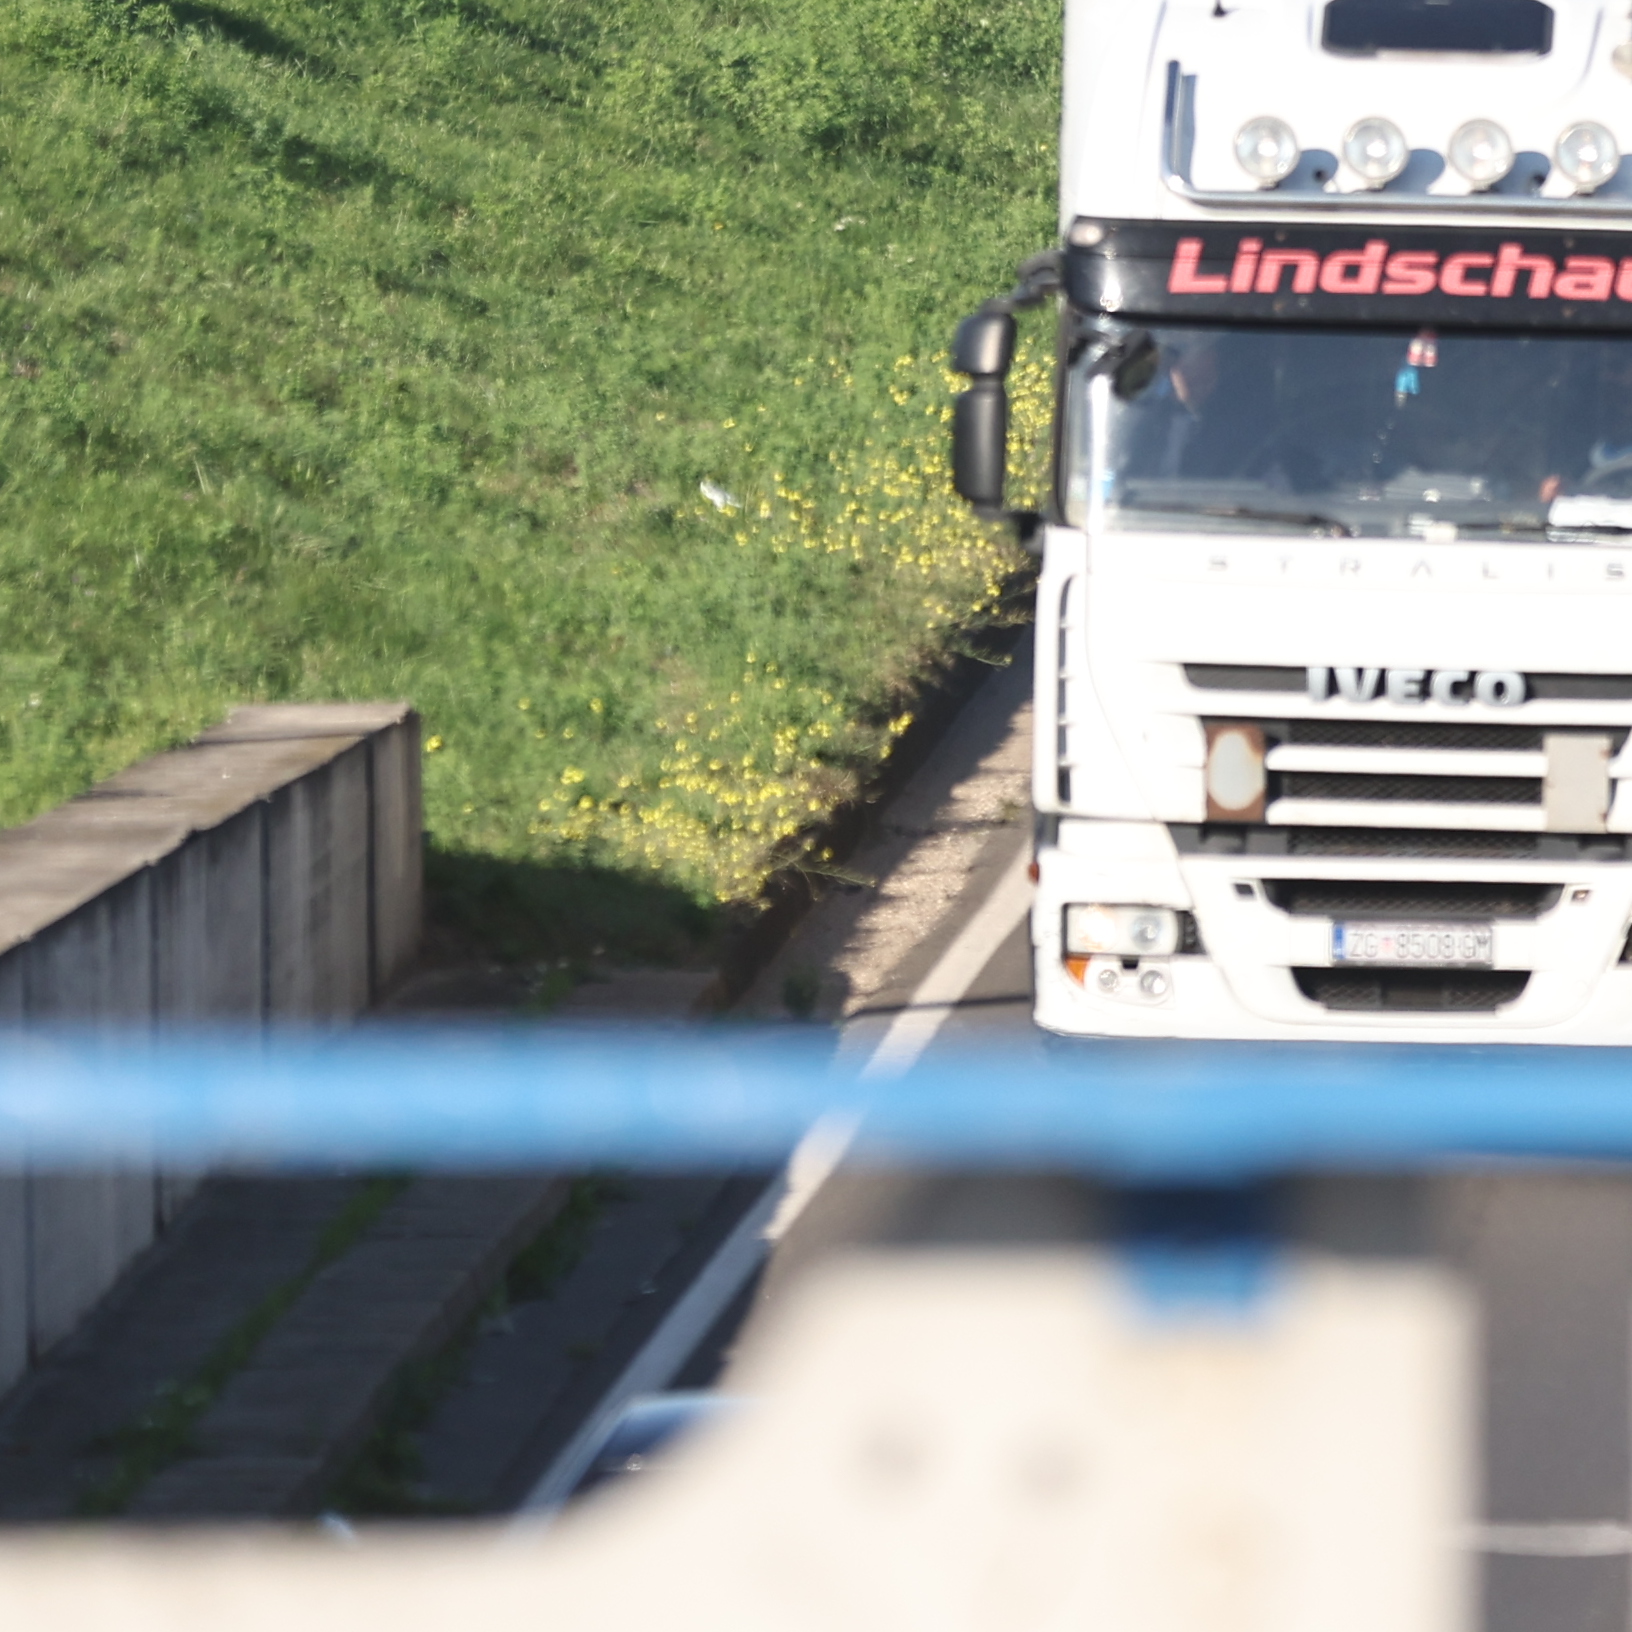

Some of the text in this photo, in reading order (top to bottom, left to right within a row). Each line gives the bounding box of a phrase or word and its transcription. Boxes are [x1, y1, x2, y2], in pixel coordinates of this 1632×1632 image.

[1207, 554, 1626, 582] STRALIS
[1308, 665, 1524, 708] IVECO
[1349, 932, 1379, 959] ZG
